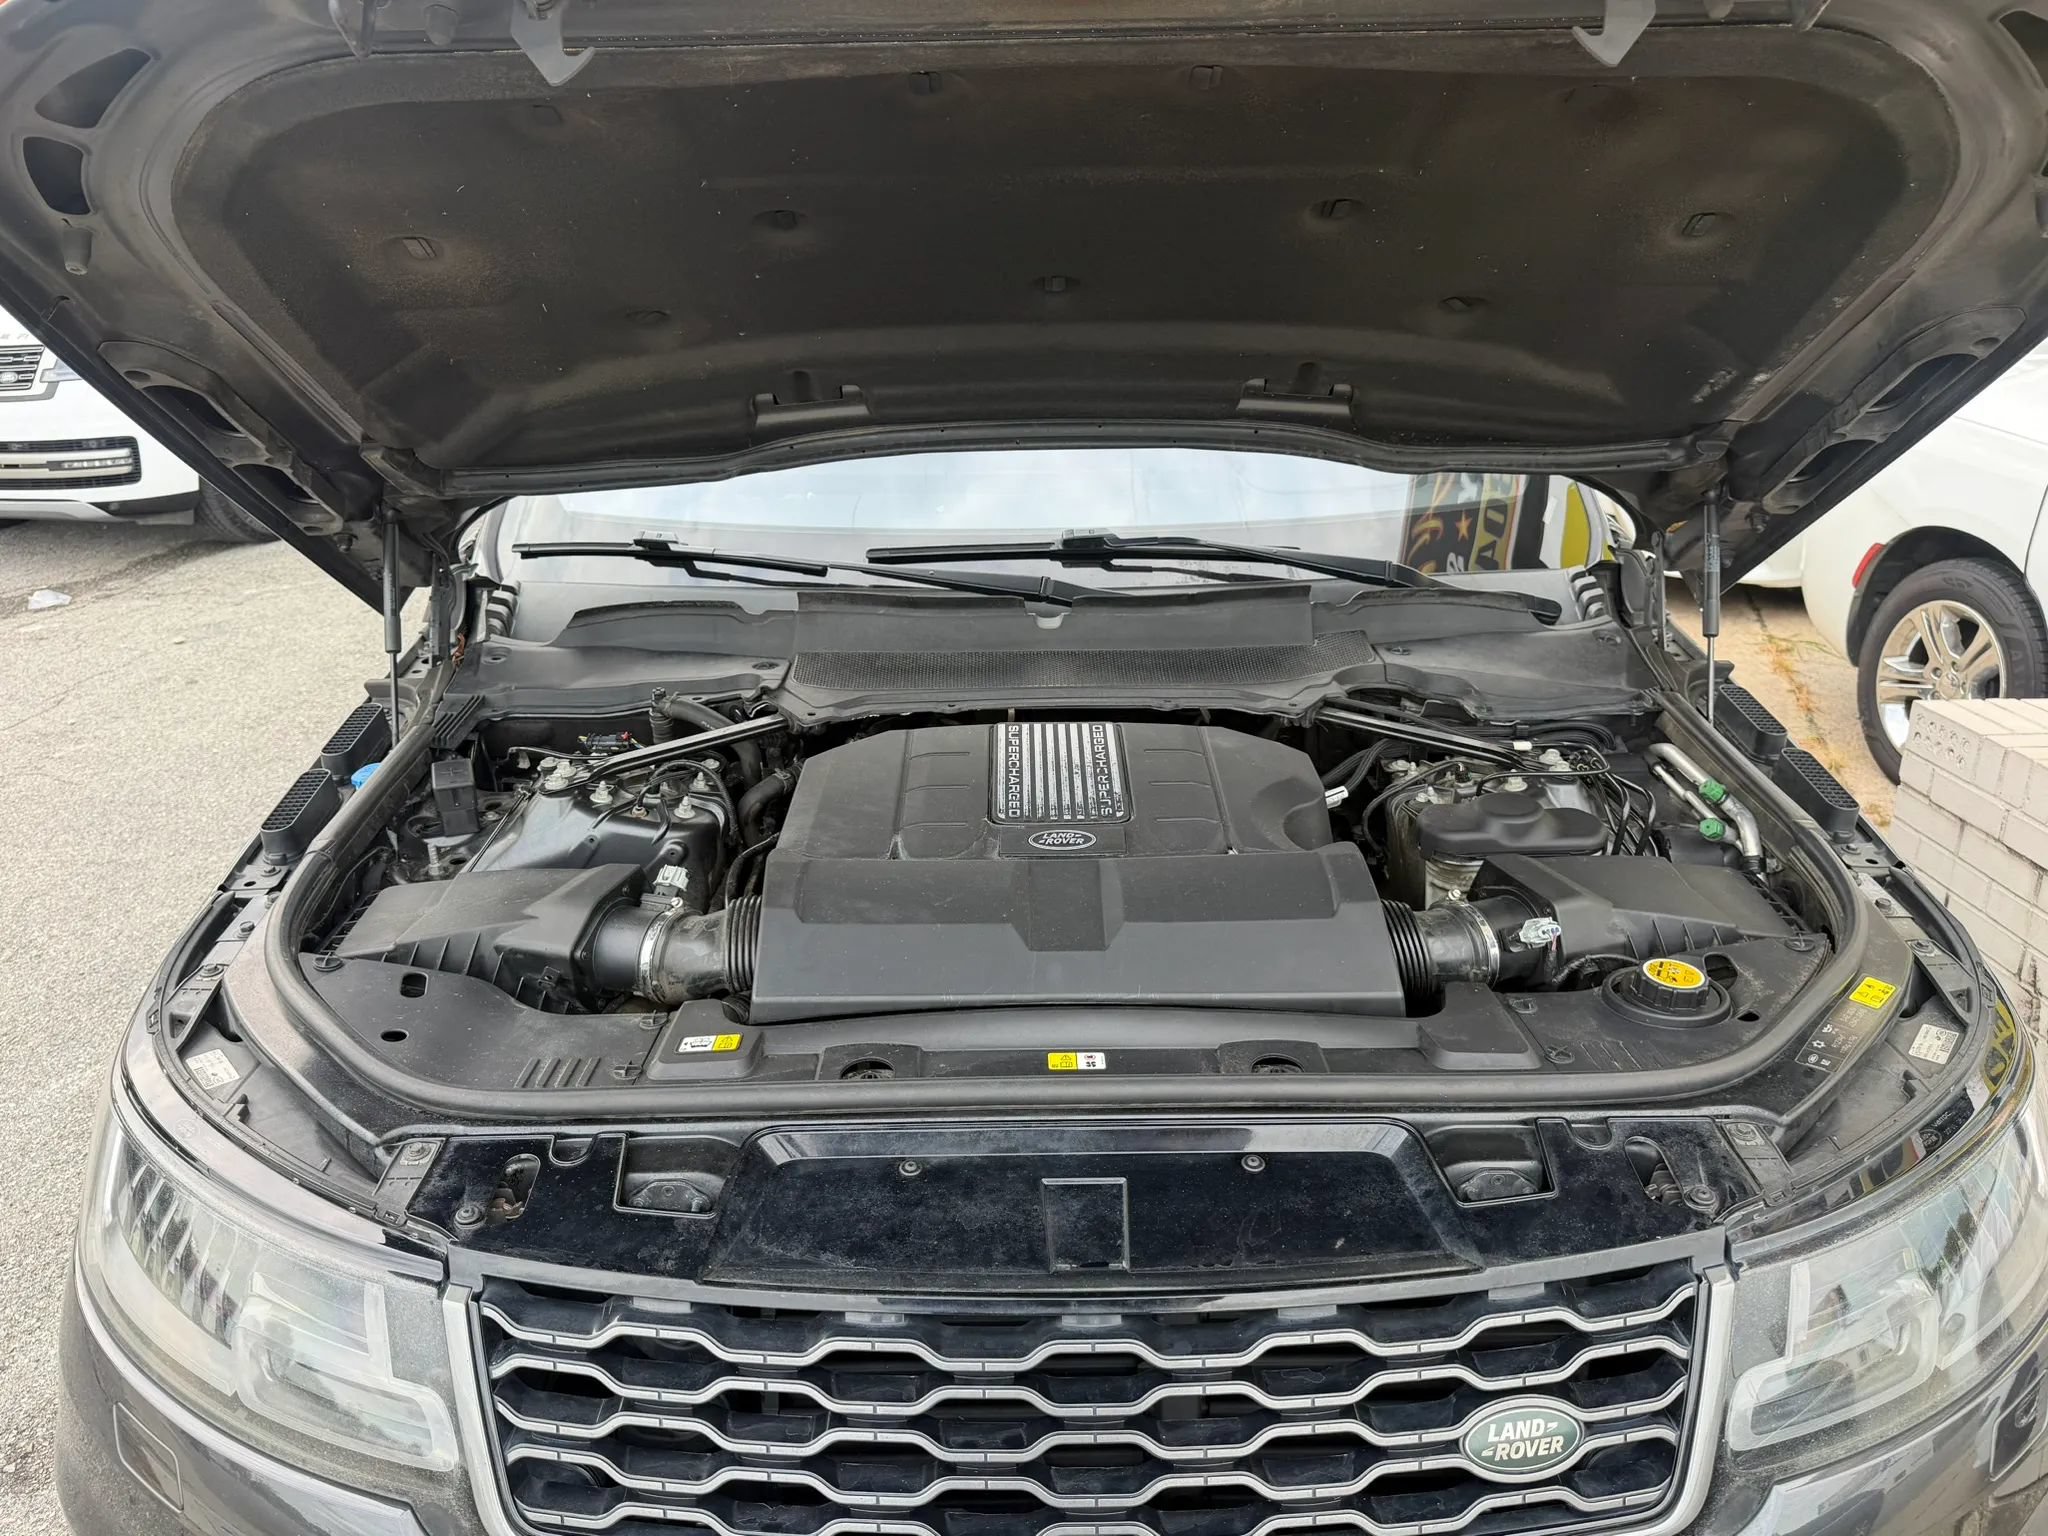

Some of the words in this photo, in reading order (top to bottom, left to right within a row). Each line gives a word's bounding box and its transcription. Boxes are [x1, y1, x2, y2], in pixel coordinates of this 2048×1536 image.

[1007, 725, 1021, 818] SUPERCHARGED
[1092, 724, 1113, 818] SUPERCHARGED
[1045, 837, 1085, 845] ROVER
[1487, 1418, 1546, 1443] LAND
[1494, 1435, 1565, 1462] ROVER
